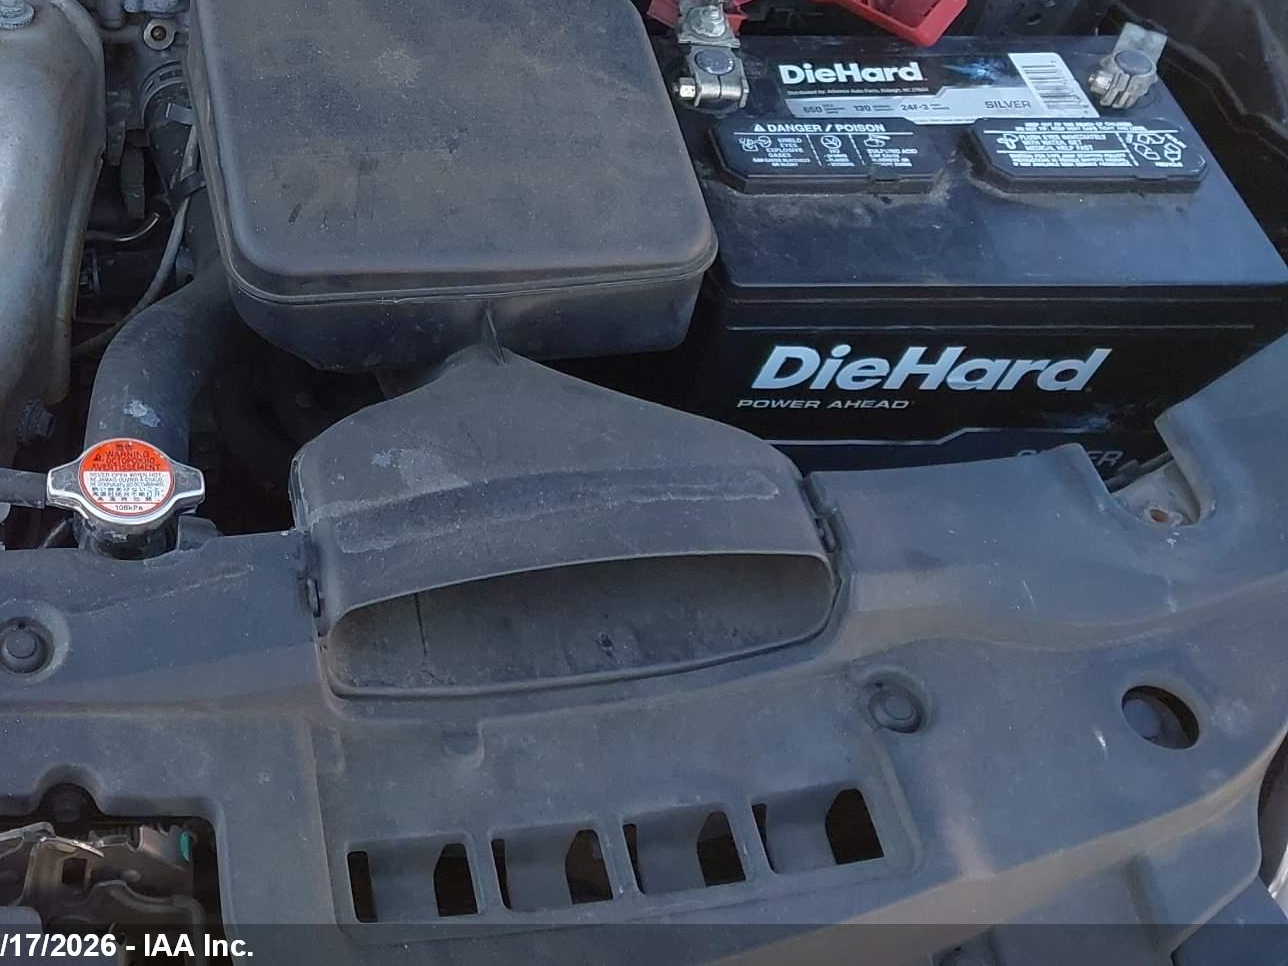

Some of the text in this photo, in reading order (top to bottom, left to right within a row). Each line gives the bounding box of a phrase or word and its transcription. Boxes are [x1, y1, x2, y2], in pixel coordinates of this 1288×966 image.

[778, 62, 924, 85] DieHard
[984, 100, 1032, 109] SILVER
[767, 124, 823, 132] DANGER
[837, 124, 886, 132] POISON
[751, 343, 1112, 392] DieHard
[736, 399, 910, 410] POWER AHEAD
[105, 450, 150, 458] WARNING
